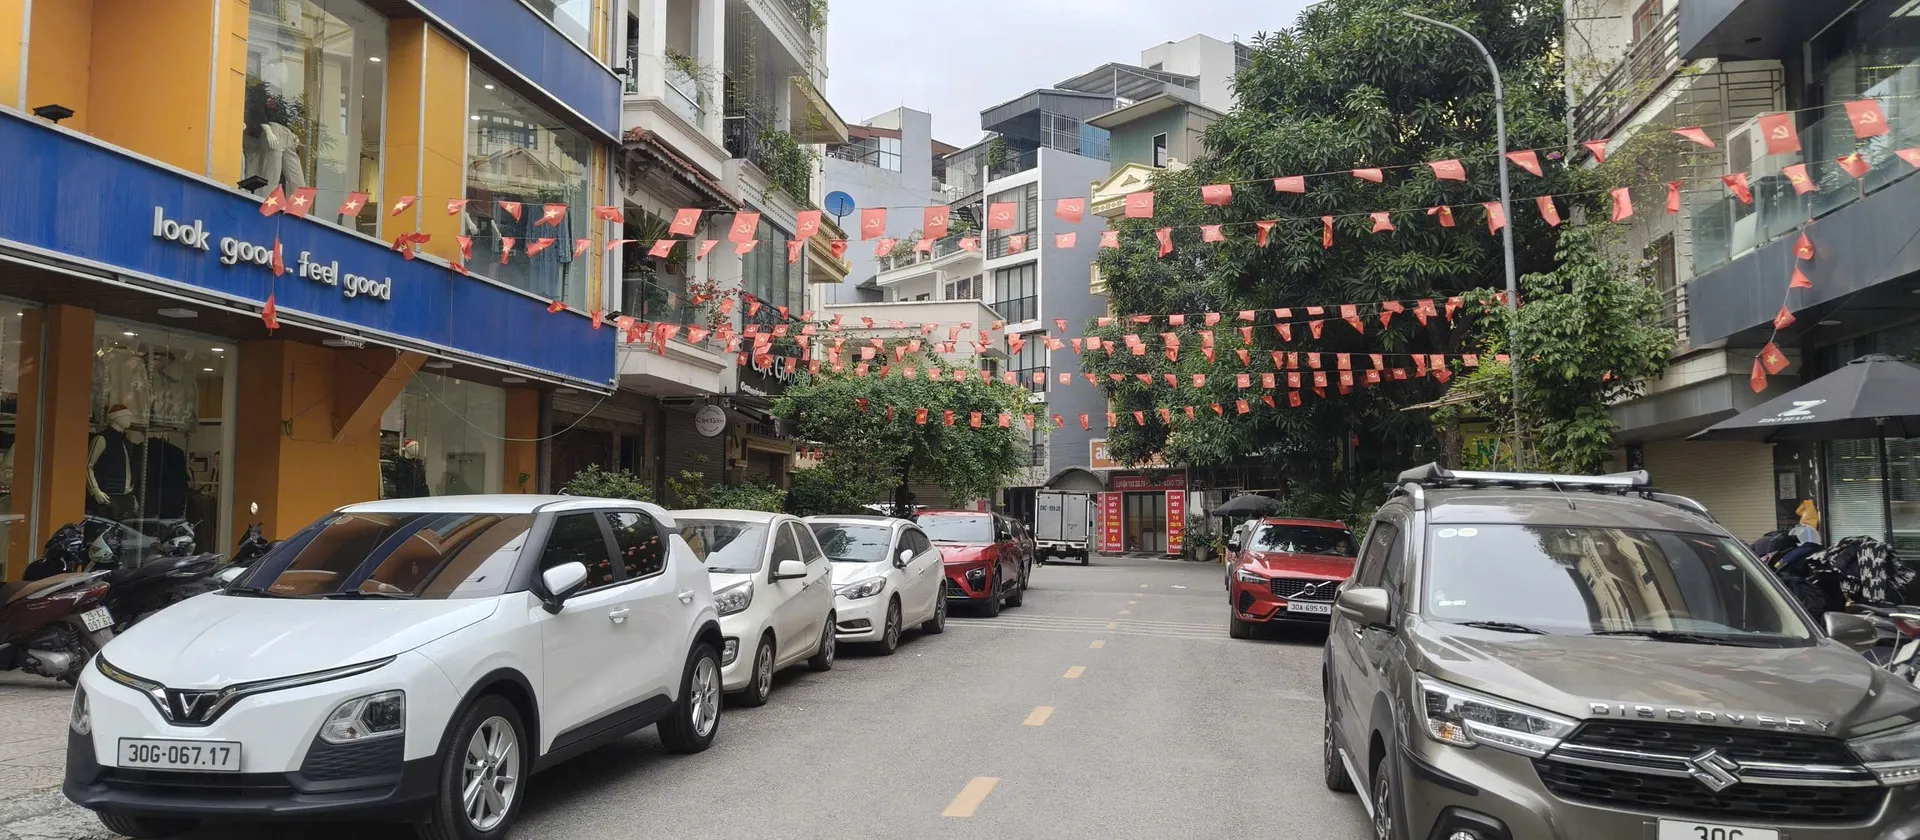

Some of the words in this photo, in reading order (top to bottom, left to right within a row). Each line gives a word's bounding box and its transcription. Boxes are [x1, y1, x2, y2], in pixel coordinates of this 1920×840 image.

[153, 206, 210, 251] look
[298, 251, 339, 286] feel
[343, 273, 391, 300] good
[1589, 702, 1833, 731] DISCOVERY
[128, 743, 231, 766] 30G-067.17
